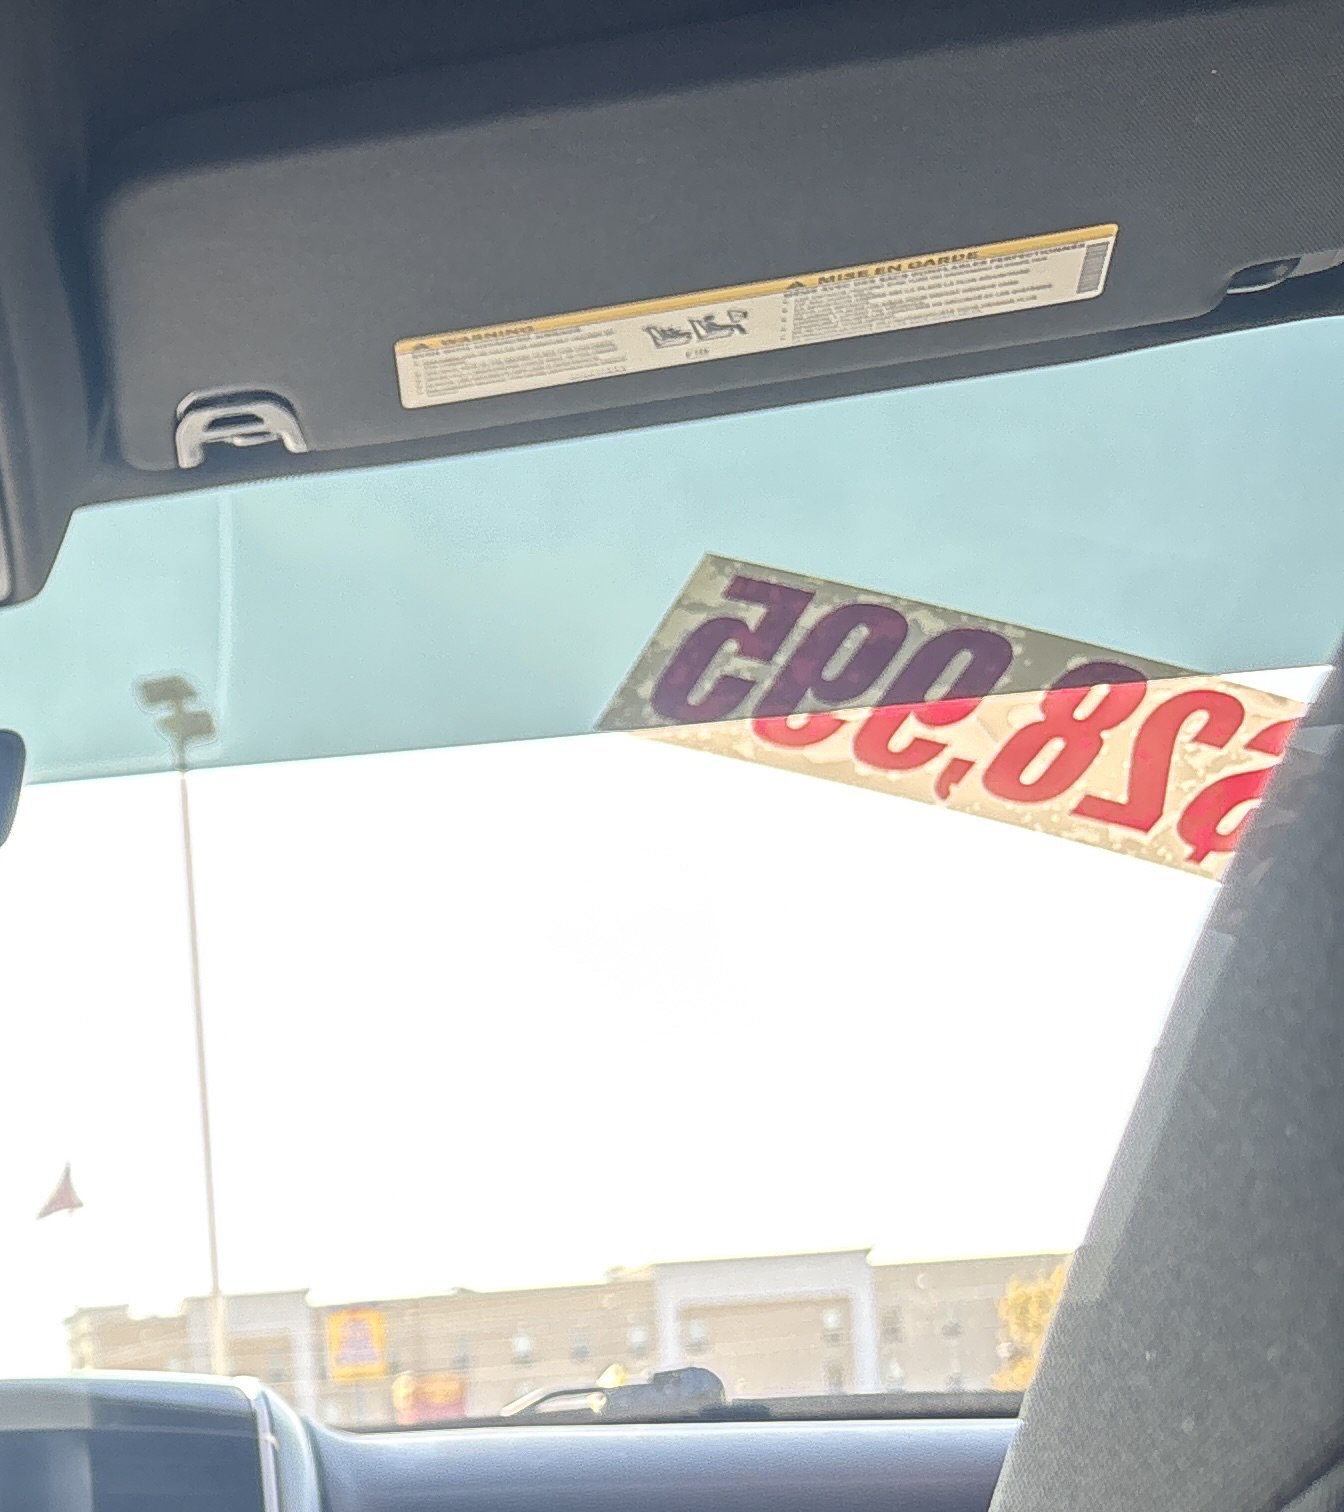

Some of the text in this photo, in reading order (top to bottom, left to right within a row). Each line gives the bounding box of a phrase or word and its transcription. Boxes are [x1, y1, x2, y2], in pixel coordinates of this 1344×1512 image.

[818, 250, 978, 285] MISE EN GARDE
[440, 325, 534, 345] WARNING
